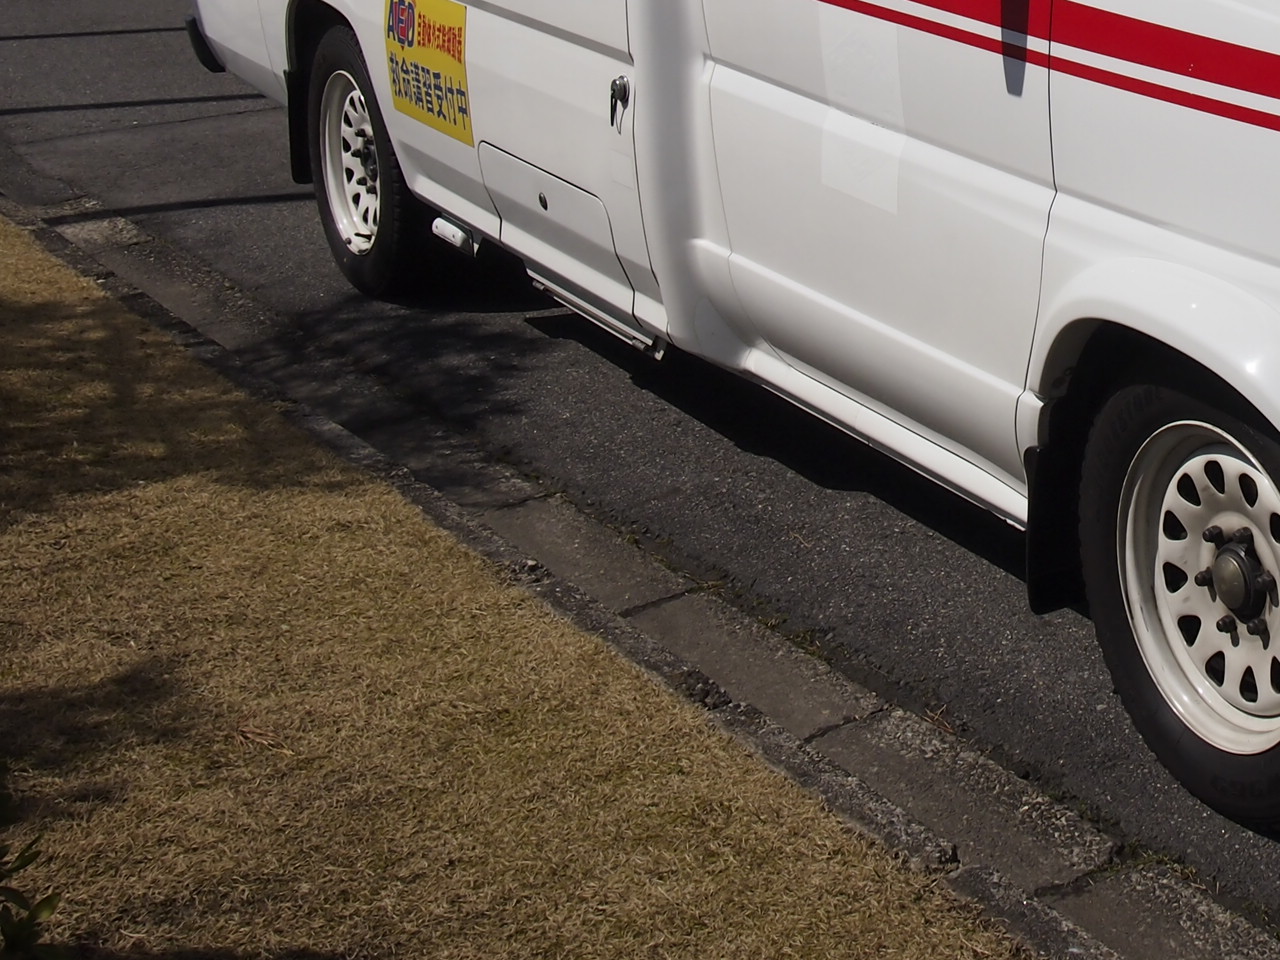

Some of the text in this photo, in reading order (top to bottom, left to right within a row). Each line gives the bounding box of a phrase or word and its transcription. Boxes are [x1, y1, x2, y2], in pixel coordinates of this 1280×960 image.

[389, 50, 468, 131] 救命講習受付中
